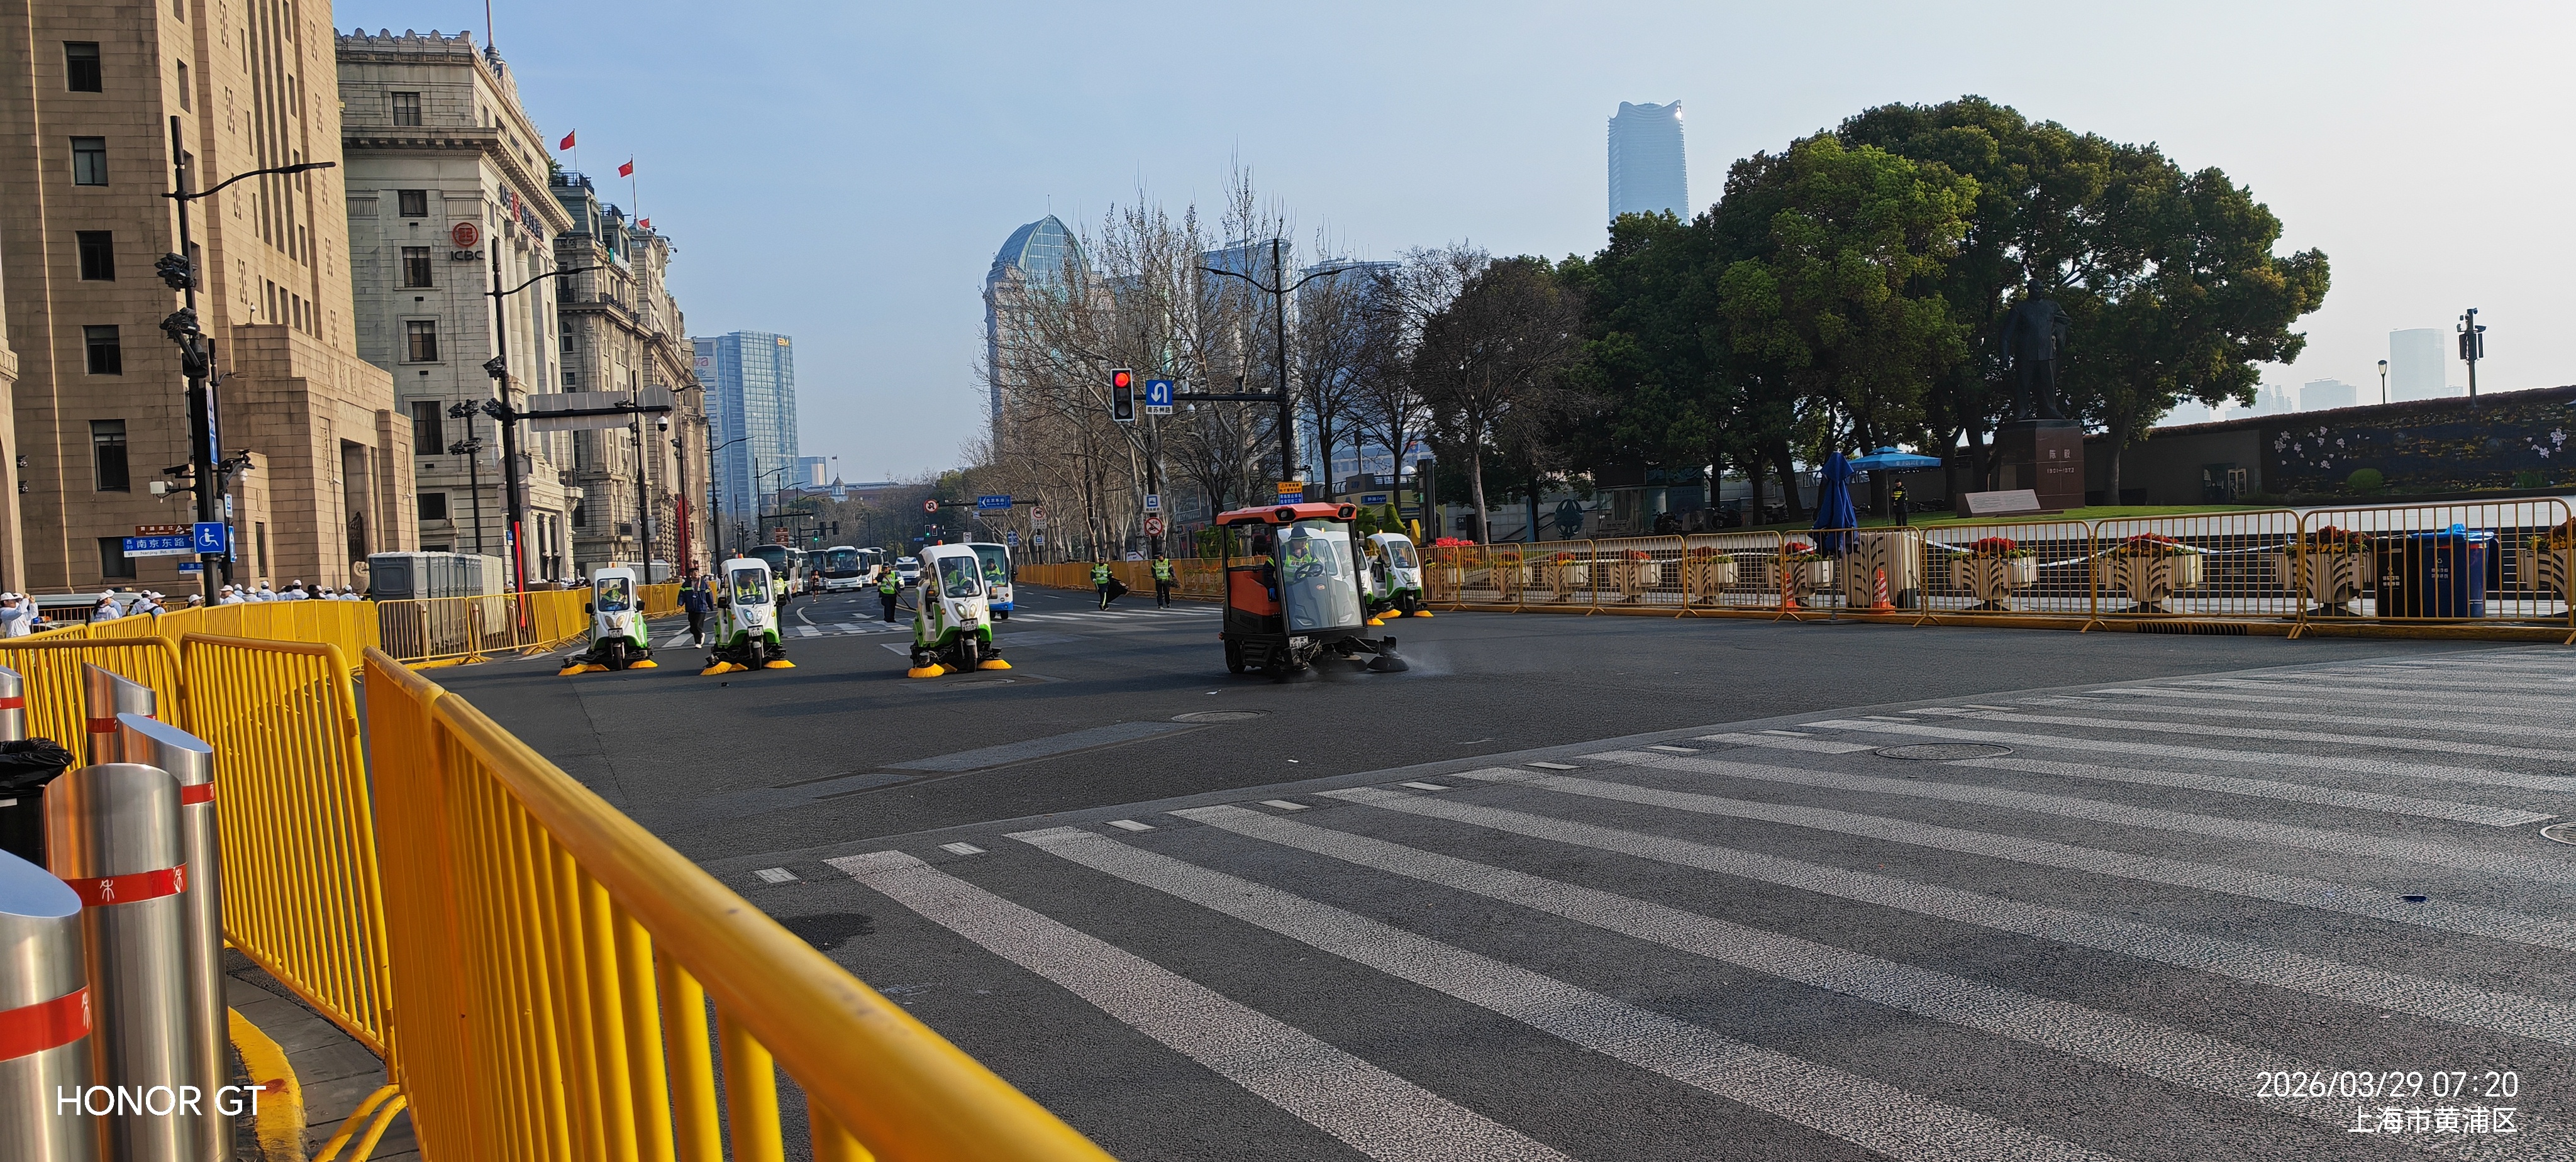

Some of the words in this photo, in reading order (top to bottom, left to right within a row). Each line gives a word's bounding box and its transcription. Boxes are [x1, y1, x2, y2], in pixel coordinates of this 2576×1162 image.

[450, 250, 486, 261] ICBC
[136, 538, 184, 549] 南京东路
